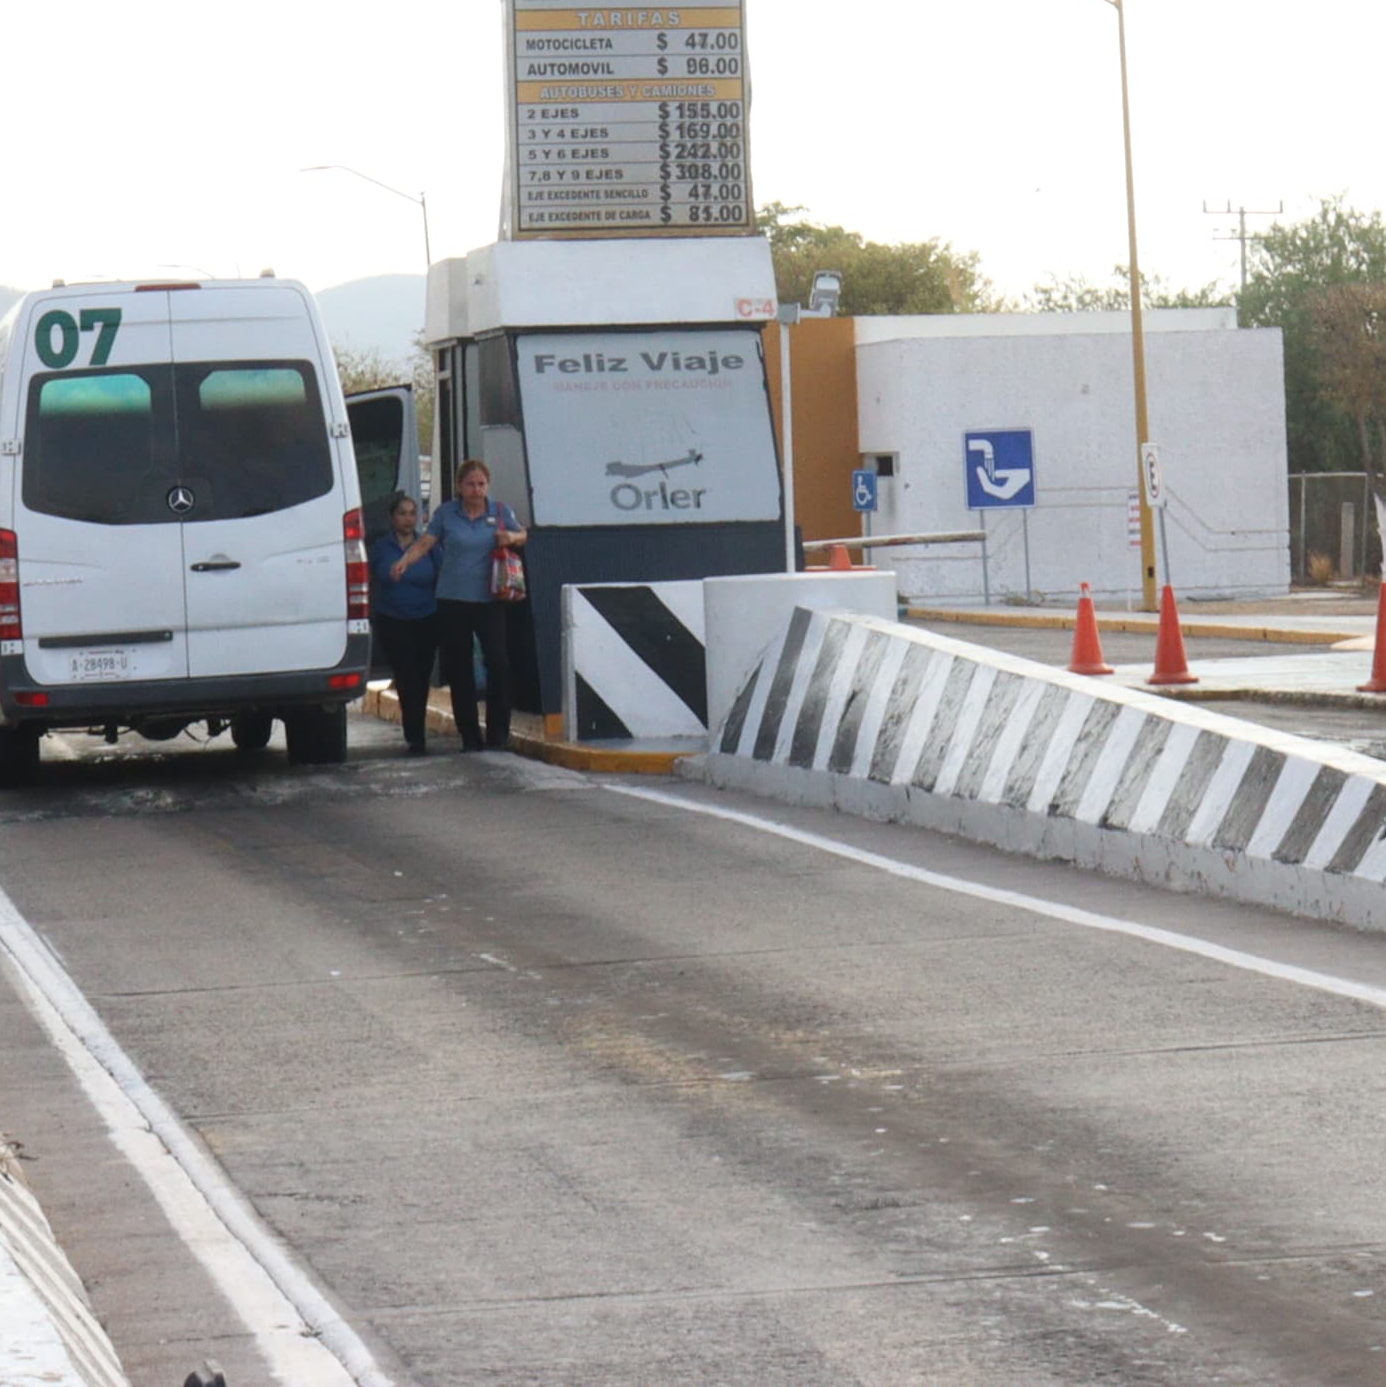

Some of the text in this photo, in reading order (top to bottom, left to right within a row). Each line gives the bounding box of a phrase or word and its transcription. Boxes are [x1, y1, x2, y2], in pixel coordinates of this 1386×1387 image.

[576, 10, 681, 27] TARIFAS
[526, 38, 613, 51] MOTOCICLETA
[657, 32, 668, 51] $
[527, 62, 614, 76] AUTOMOVIL
[657, 57, 668, 76] $
[540, 84, 715, 99] AUTOBUSES Y CAMIONES
[528, 101, 740, 121] 2 EJES $ 155.00
[528, 121, 741, 140] 3 Y 4 EJES $ 169.00
[528, 149, 537, 160] 5
[543, 148, 552, 159] Y
[571, 147, 609, 159] EJES
[659, 141, 671, 161] $
[556, 170, 566, 181] Y
[571, 170, 580, 181] 9
[585, 168, 624, 181] EJES
[659, 162, 671, 181] $
[528, 191, 544, 201] EJE
[547, 189, 601, 201] EXCEDENTE
[604, 188, 649, 200] SENCILLO
[660, 182, 672, 202] $
[529, 212, 545, 222] EJE
[548, 211, 602, 222] EXCEDENTE
[604, 211, 617, 221] DE
[619, 209, 651, 221] CARGA
[660, 204, 672, 224] $
[737, 298, 775, 317] C-4
[35, 307, 123, 369] 07
[533, 350, 744, 375] Feliz Viaje
[609, 481, 708, 512] Orler
